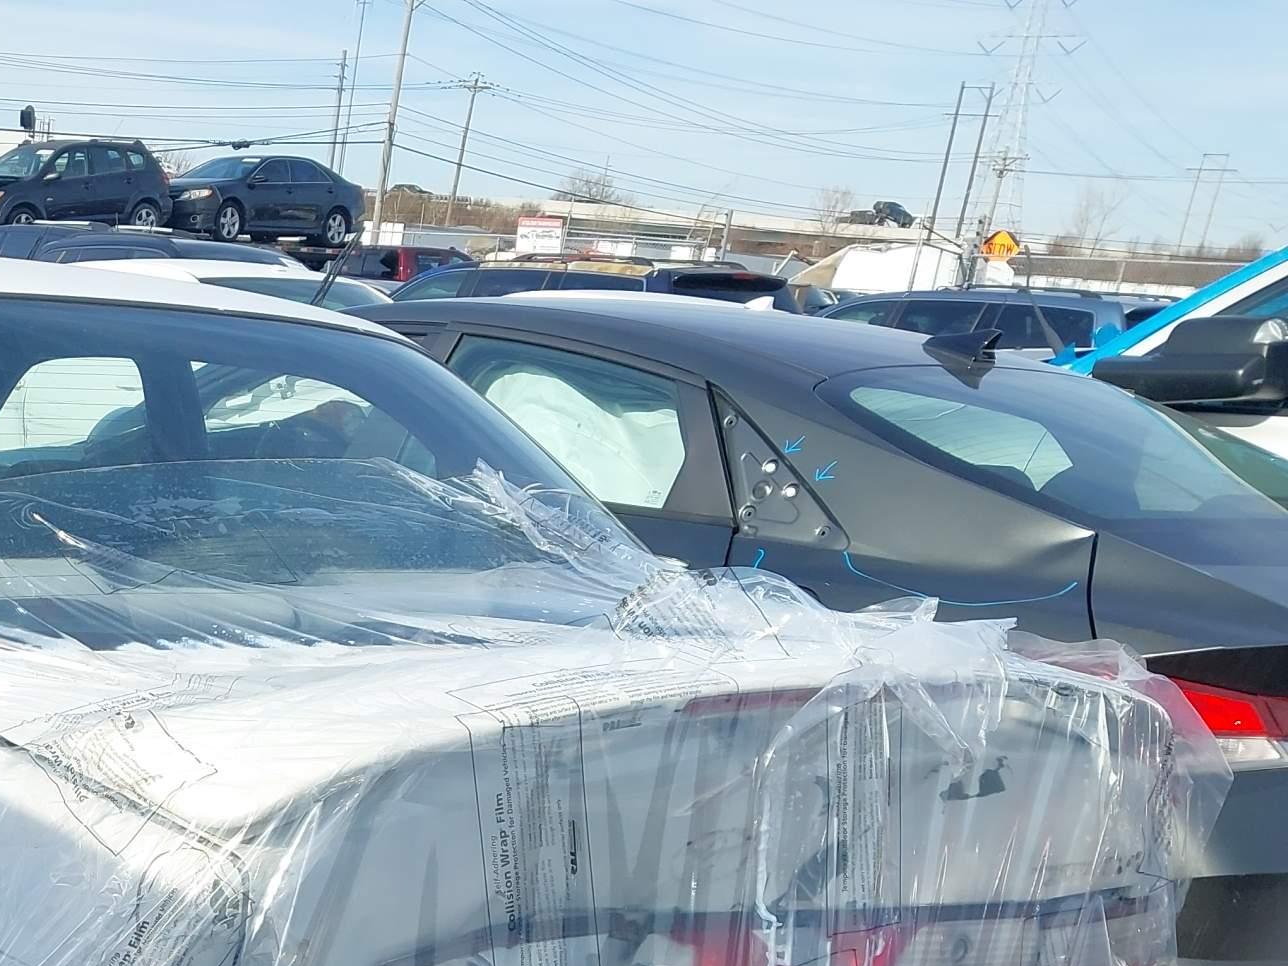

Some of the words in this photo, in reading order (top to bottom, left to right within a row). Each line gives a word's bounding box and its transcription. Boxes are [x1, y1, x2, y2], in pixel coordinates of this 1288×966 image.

[504, 777, 513, 814] Damaged
[841, 760, 849, 796] Protection
[495, 792, 505, 824] Film
[499, 830, 511, 868] Wrap
[511, 830, 519, 870] Protection
[504, 871, 516, 932] Collision
[127, 919, 150, 949] Film
